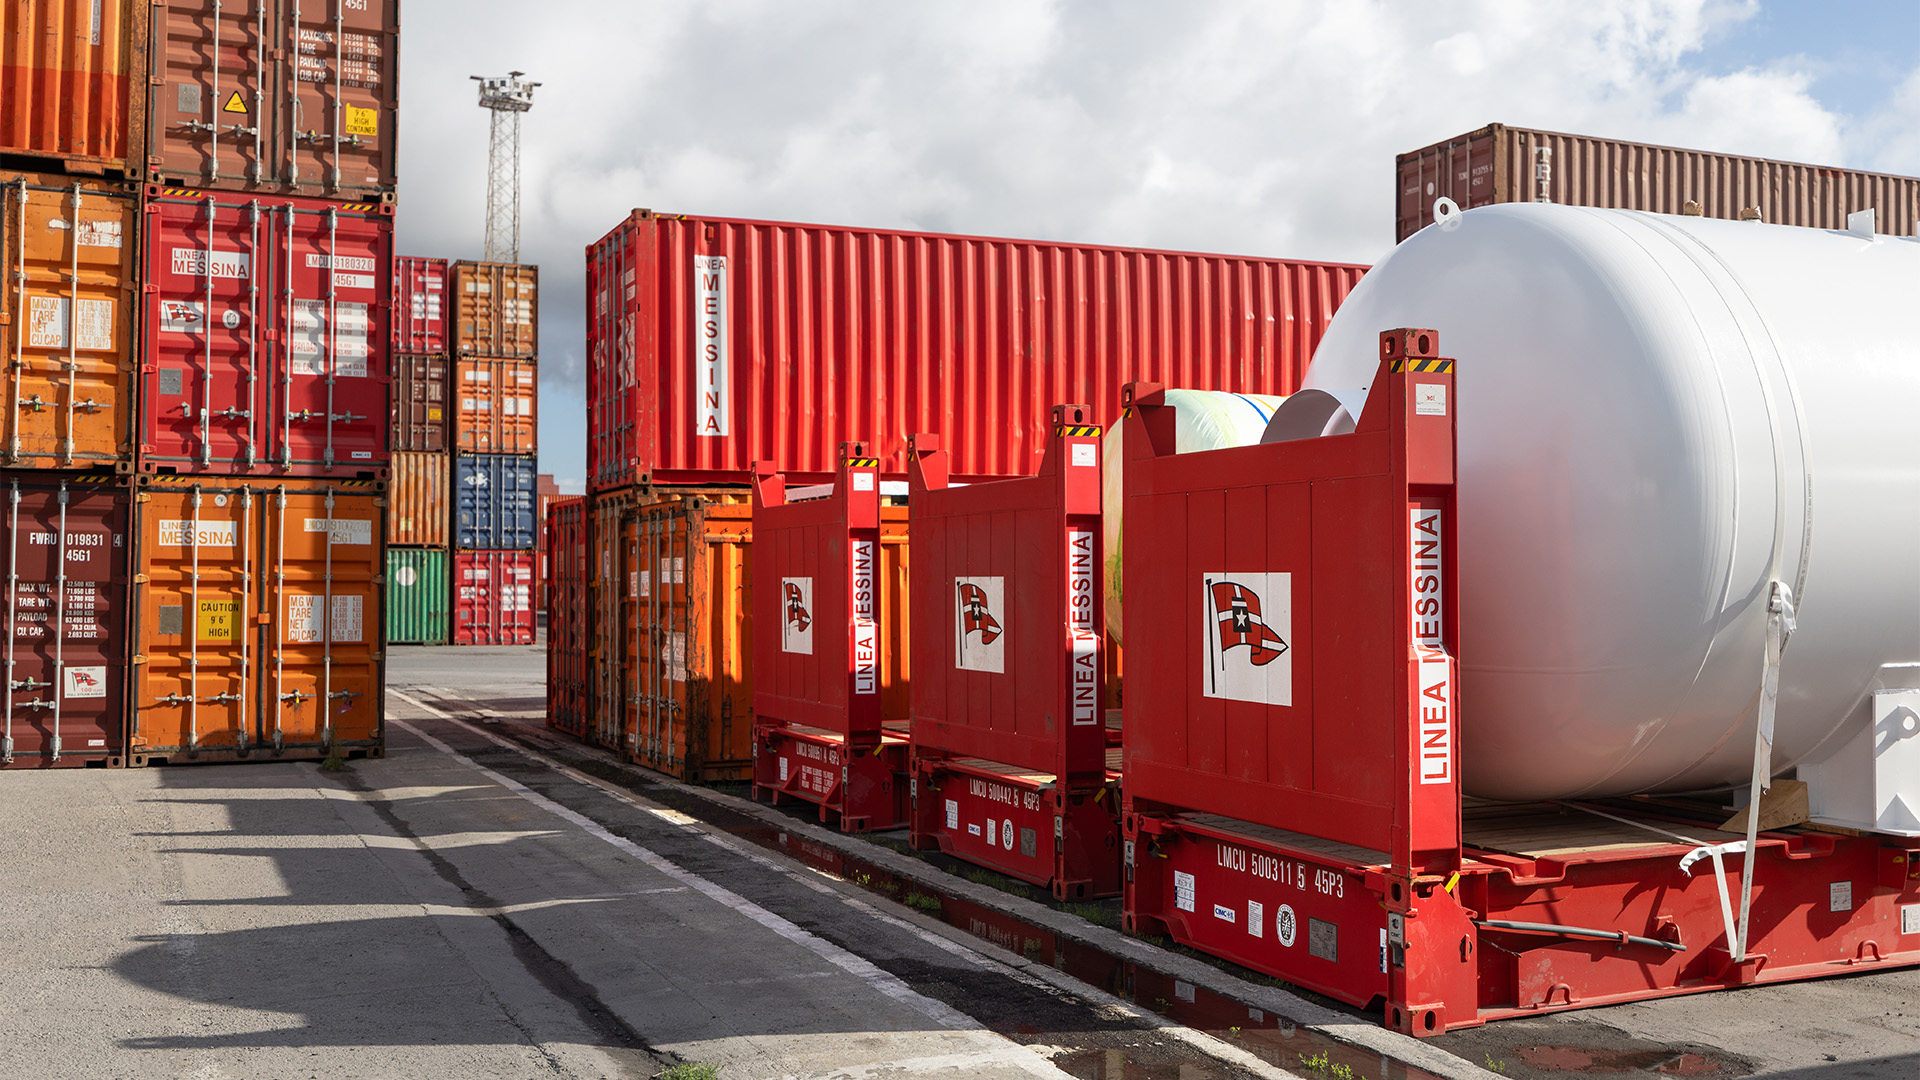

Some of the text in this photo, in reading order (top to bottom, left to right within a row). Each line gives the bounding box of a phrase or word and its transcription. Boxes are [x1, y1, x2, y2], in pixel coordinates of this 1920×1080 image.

[300, 43, 316, 55] TARE
[300, 57, 327, 69] PAYLOAD
[354, 117, 369, 125] HIGH
[346, 125, 376, 134] CONTAINER
[1535, 146, 1552, 203] TRI
[173, 250, 206, 260] LINEA
[306, 256, 329, 267] LMCU
[696, 259, 726, 270] LINEA
[173, 260, 248, 277] MESSINA
[335, 275, 357, 286] 45G1
[32, 311, 55, 322] TARE
[31, 322, 48, 333] NET
[294, 342, 317, 353] PAYLOAD
[703, 273, 721, 433] MESSINA
[161, 522, 194, 530] LINEA
[29, 532, 57, 545] FWRU
[66, 533, 104, 546] 019831
[161, 531, 235, 545] MESSINA
[330, 532, 353, 543] 45G1
[66, 549, 91, 562] 45G1
[18, 583, 37, 593] MAX.
[38, 583, 53, 593] WT.
[18, 597, 36, 607] TARE
[37, 598, 52, 607] WT.
[201, 602, 239, 612] CAUTION
[17, 612, 48, 621] PAYLOAD
[290, 607, 312, 618] TARE
[855, 544, 873, 692] LINEA MESSINA
[290, 619, 304, 629] NET
[1072, 535, 1094, 722] LINEA MESSINA
[29, 627, 45, 636] CAP.
[208, 628, 229, 637] HIGH
[1414, 514, 1448, 780] LINEA MESSINA
[969, 778, 987, 798] LMCU
[988, 783, 1012, 805] 500442
[1023, 791, 1040, 812] 45P3
[1217, 844, 1344, 899] LMCU 500311 5 45P3
[1214, 908, 1227, 917] CIMC
